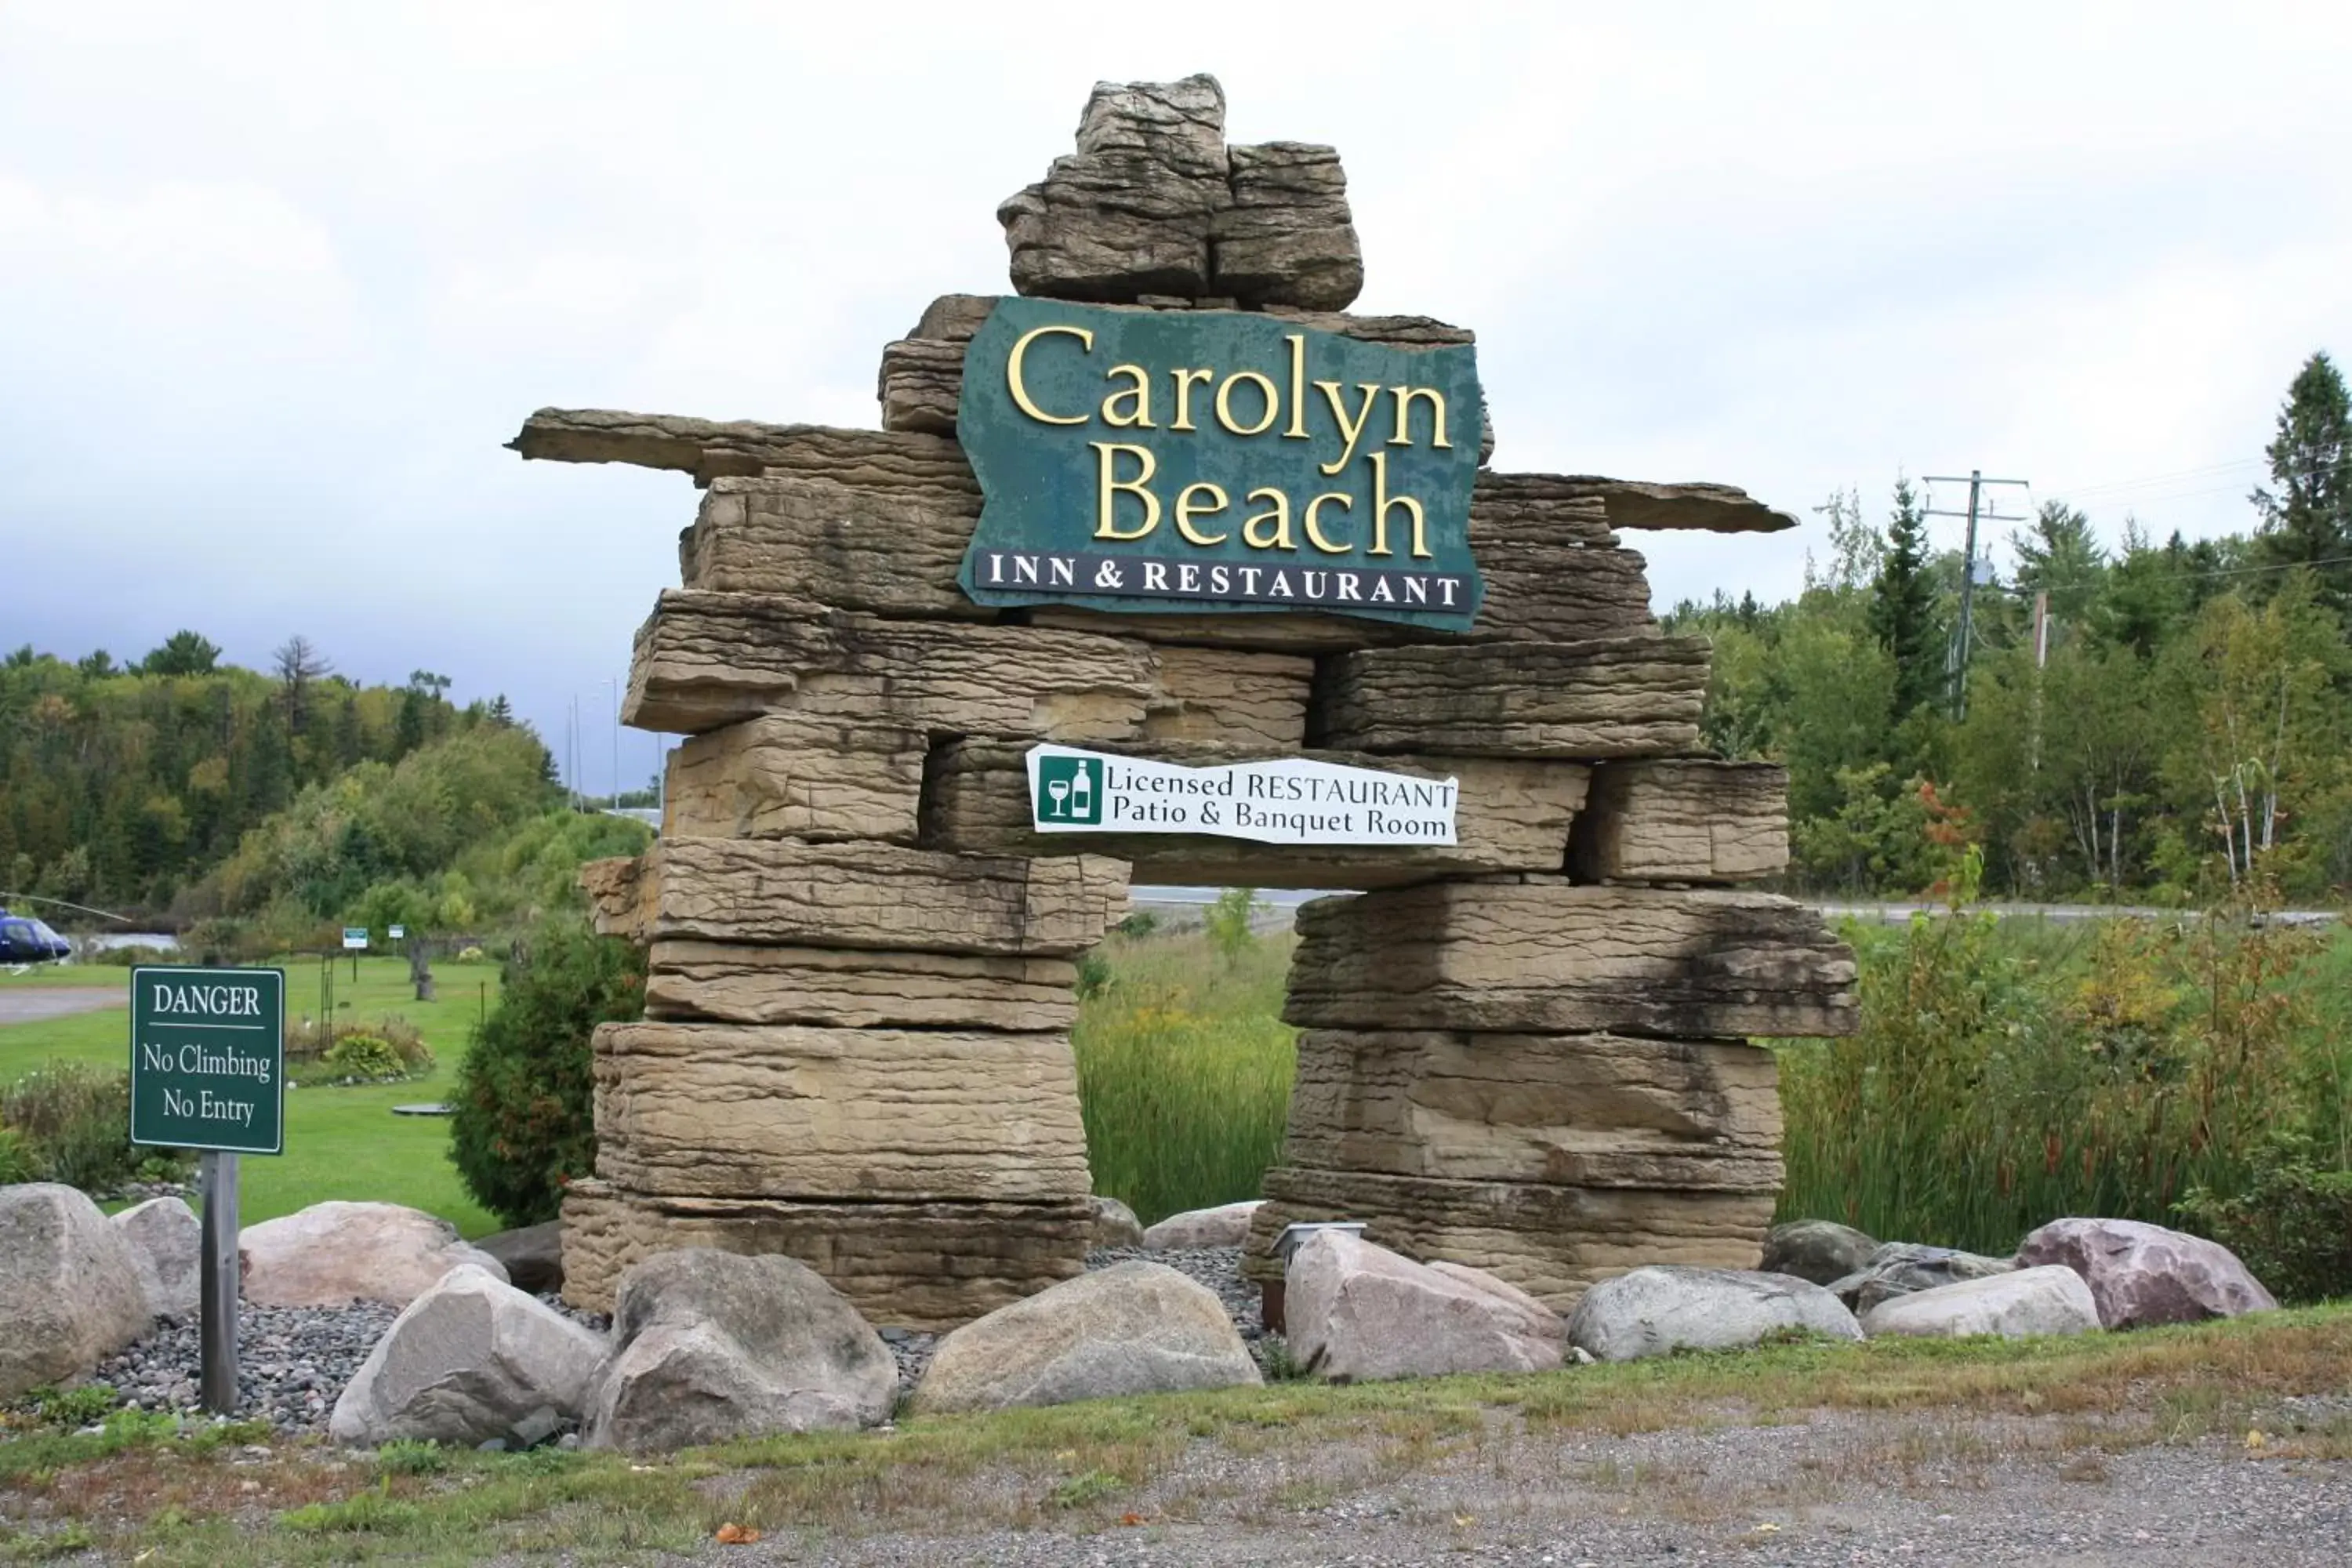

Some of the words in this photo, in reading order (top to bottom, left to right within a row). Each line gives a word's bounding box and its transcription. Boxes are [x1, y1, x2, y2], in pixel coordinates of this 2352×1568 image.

[1007, 326, 1453, 474] Carolyn
[1089, 441, 1432, 557] Beach
[989, 554, 1076, 586] INN
[1094, 560, 1124, 589] &
[1143, 562, 1459, 606] RESTAURANT
[1107, 767, 1233, 797] Licensed
[1247, 775, 1455, 808] RESTAURANT
[1112, 796, 1186, 823] Patio
[1200, 801, 1221, 825] &
[1236, 804, 1354, 837] Banquet
[1367, 811, 1448, 837] Room
[153, 985, 261, 1015] DANGER
[143, 1044, 173, 1072] No
[179, 1044, 270, 1083] Climbing
[163, 1088, 194, 1117] No
[200, 1091, 255, 1127] Entry
